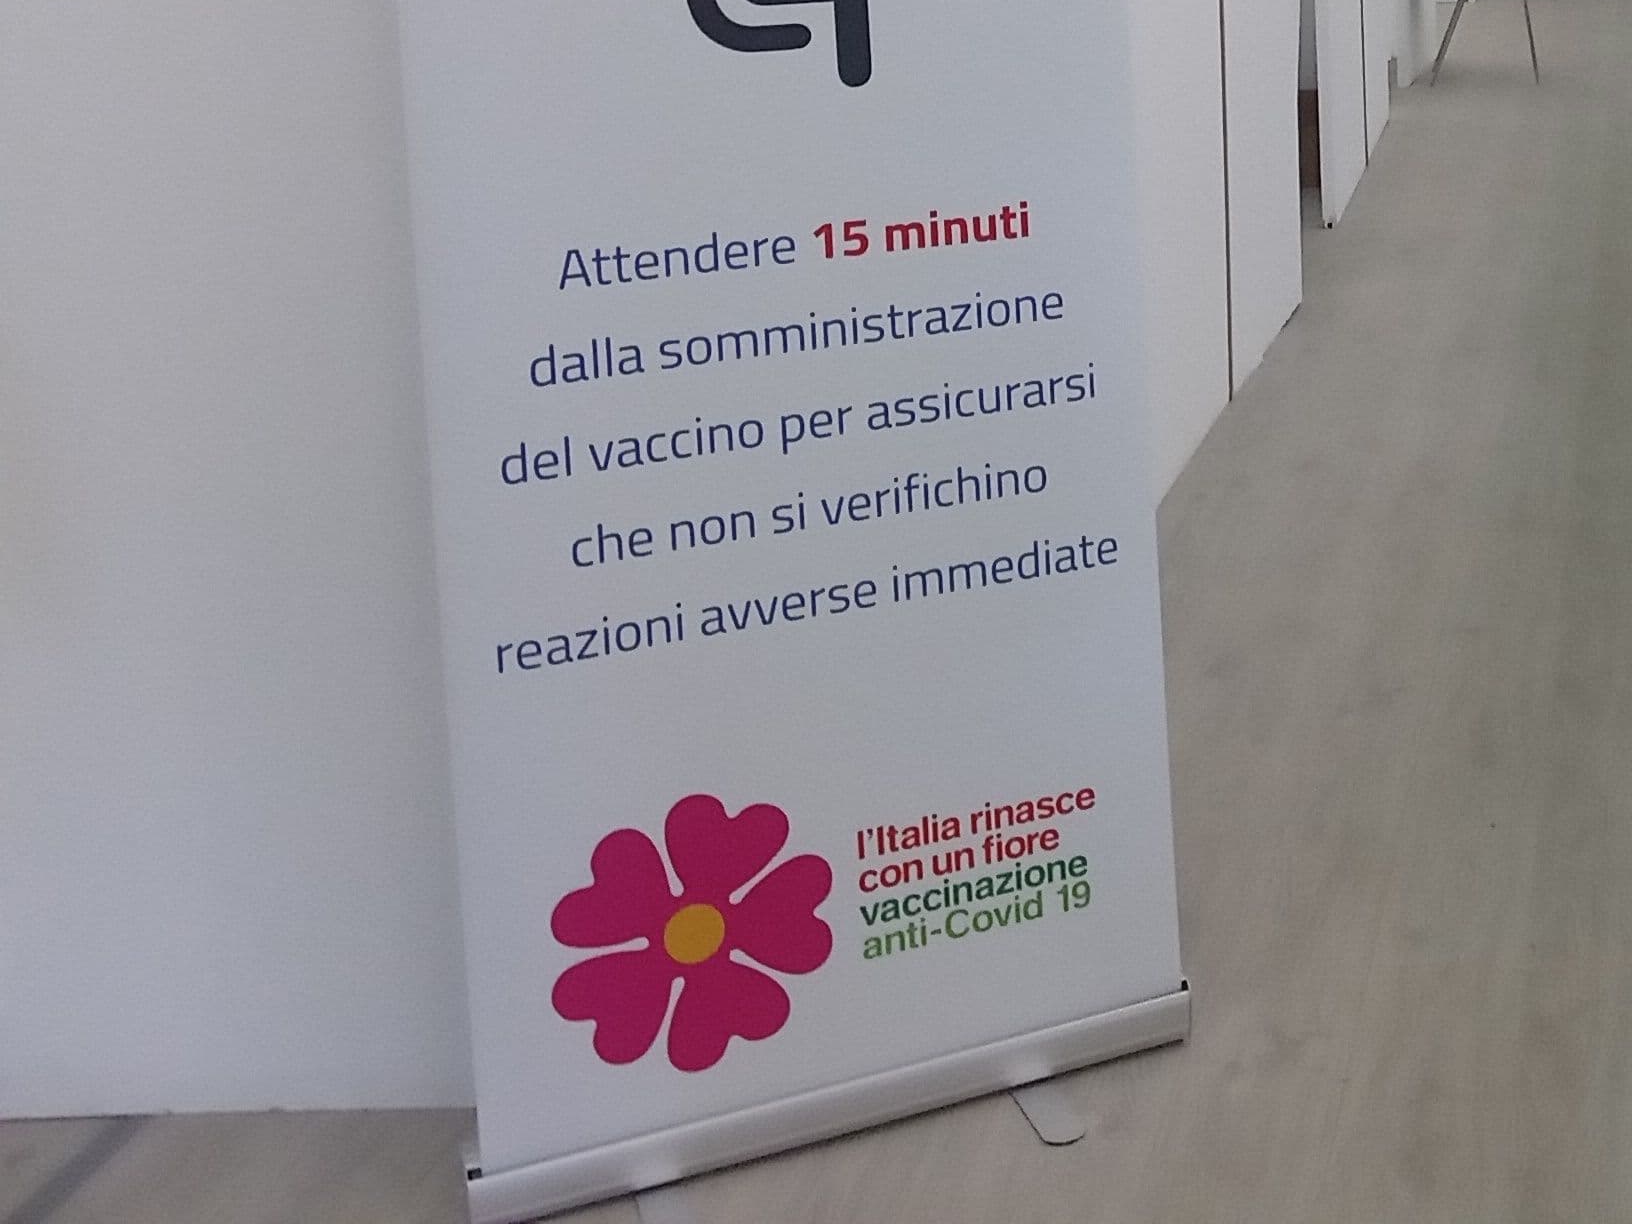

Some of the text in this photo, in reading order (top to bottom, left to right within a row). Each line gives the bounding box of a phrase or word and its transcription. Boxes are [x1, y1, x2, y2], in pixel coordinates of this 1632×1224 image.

[560, 201, 1030, 290] Attendere 15 minuti
[531, 292, 1063, 387] dalla somministrazione
[502, 363, 1094, 484] del vaccino per assicurarsi
[573, 463, 1046, 567] che non si verifichino
[497, 536, 1117, 673] reazioni avverse immediate
[970, 788, 1095, 834] rinasce
[859, 829, 1060, 892] con un fiore
[860, 856, 1087, 926] vaccinazione
[863, 881, 1090, 959] anti-Covid 19
